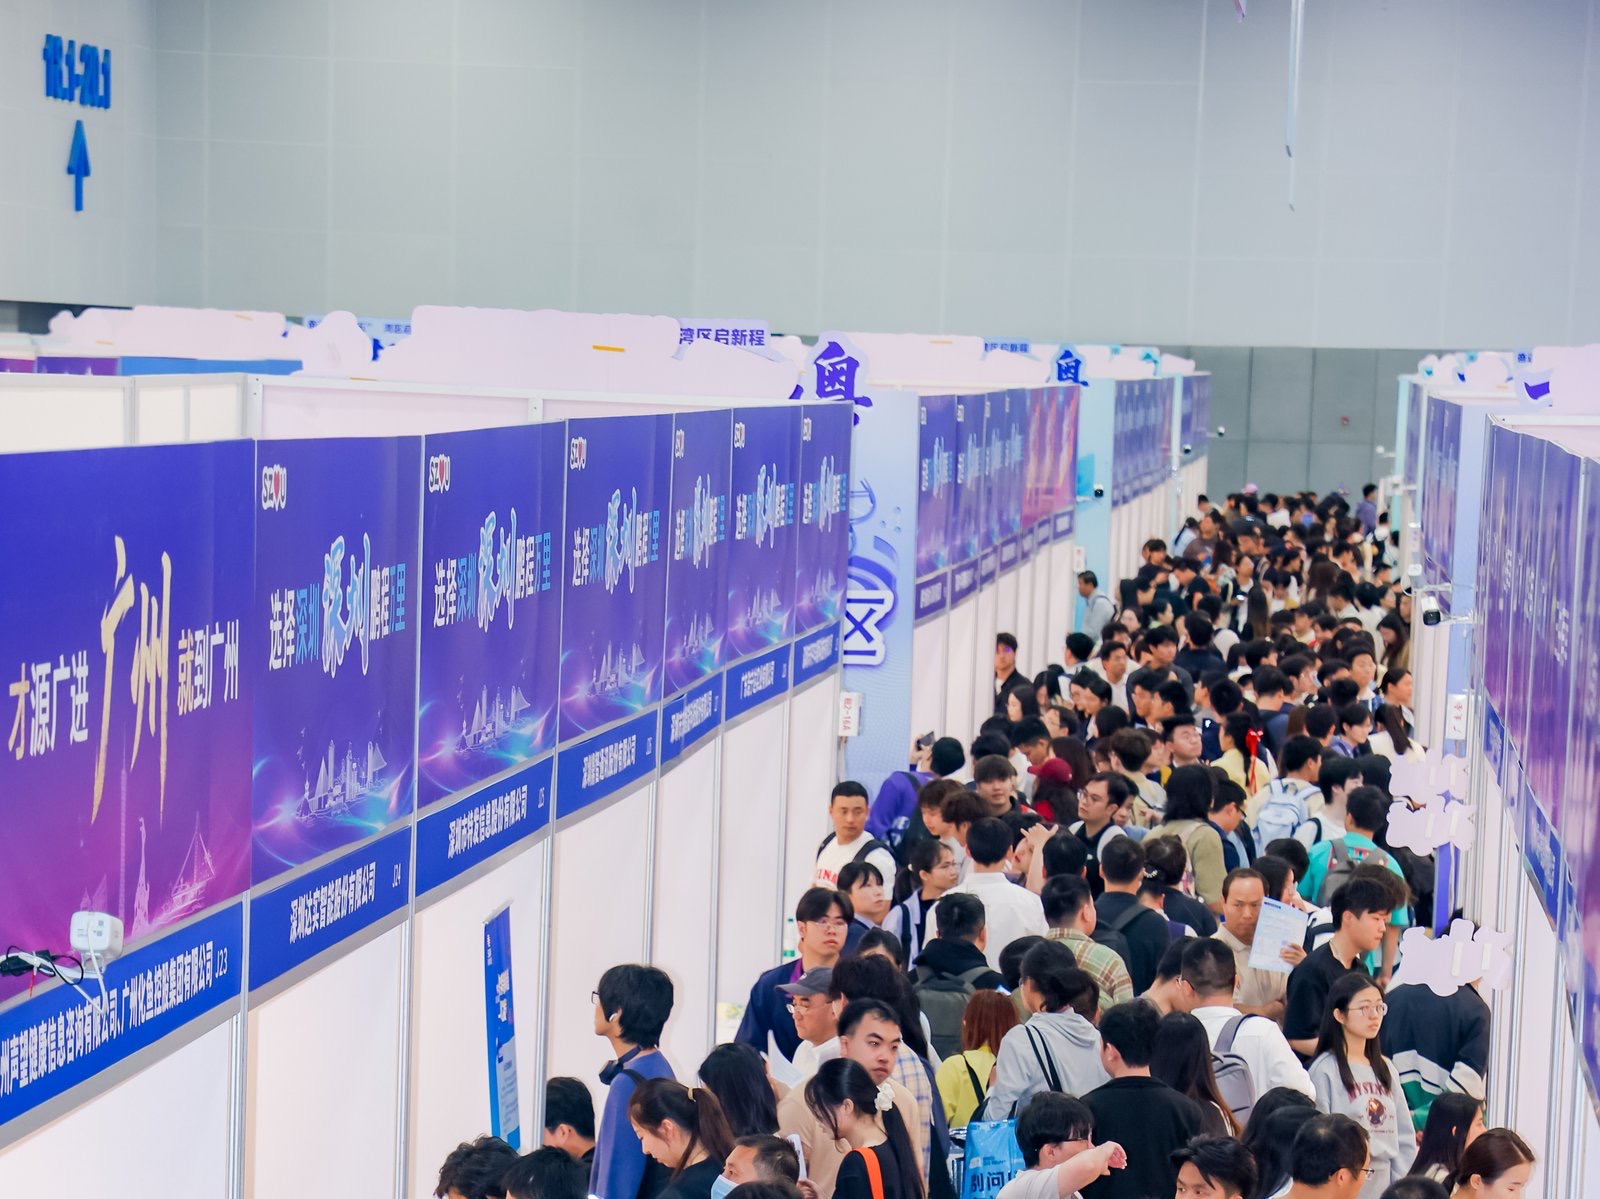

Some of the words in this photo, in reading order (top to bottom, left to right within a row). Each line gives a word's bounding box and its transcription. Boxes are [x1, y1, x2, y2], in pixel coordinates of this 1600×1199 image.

[8, 650, 90, 761] 才源广进
[177, 619, 240, 716] 就到广州
[289, 861, 377, 944] 深圳达实智能股份有限公司
[391, 863, 402, 889] J24
[215, 947, 228, 979] J23
